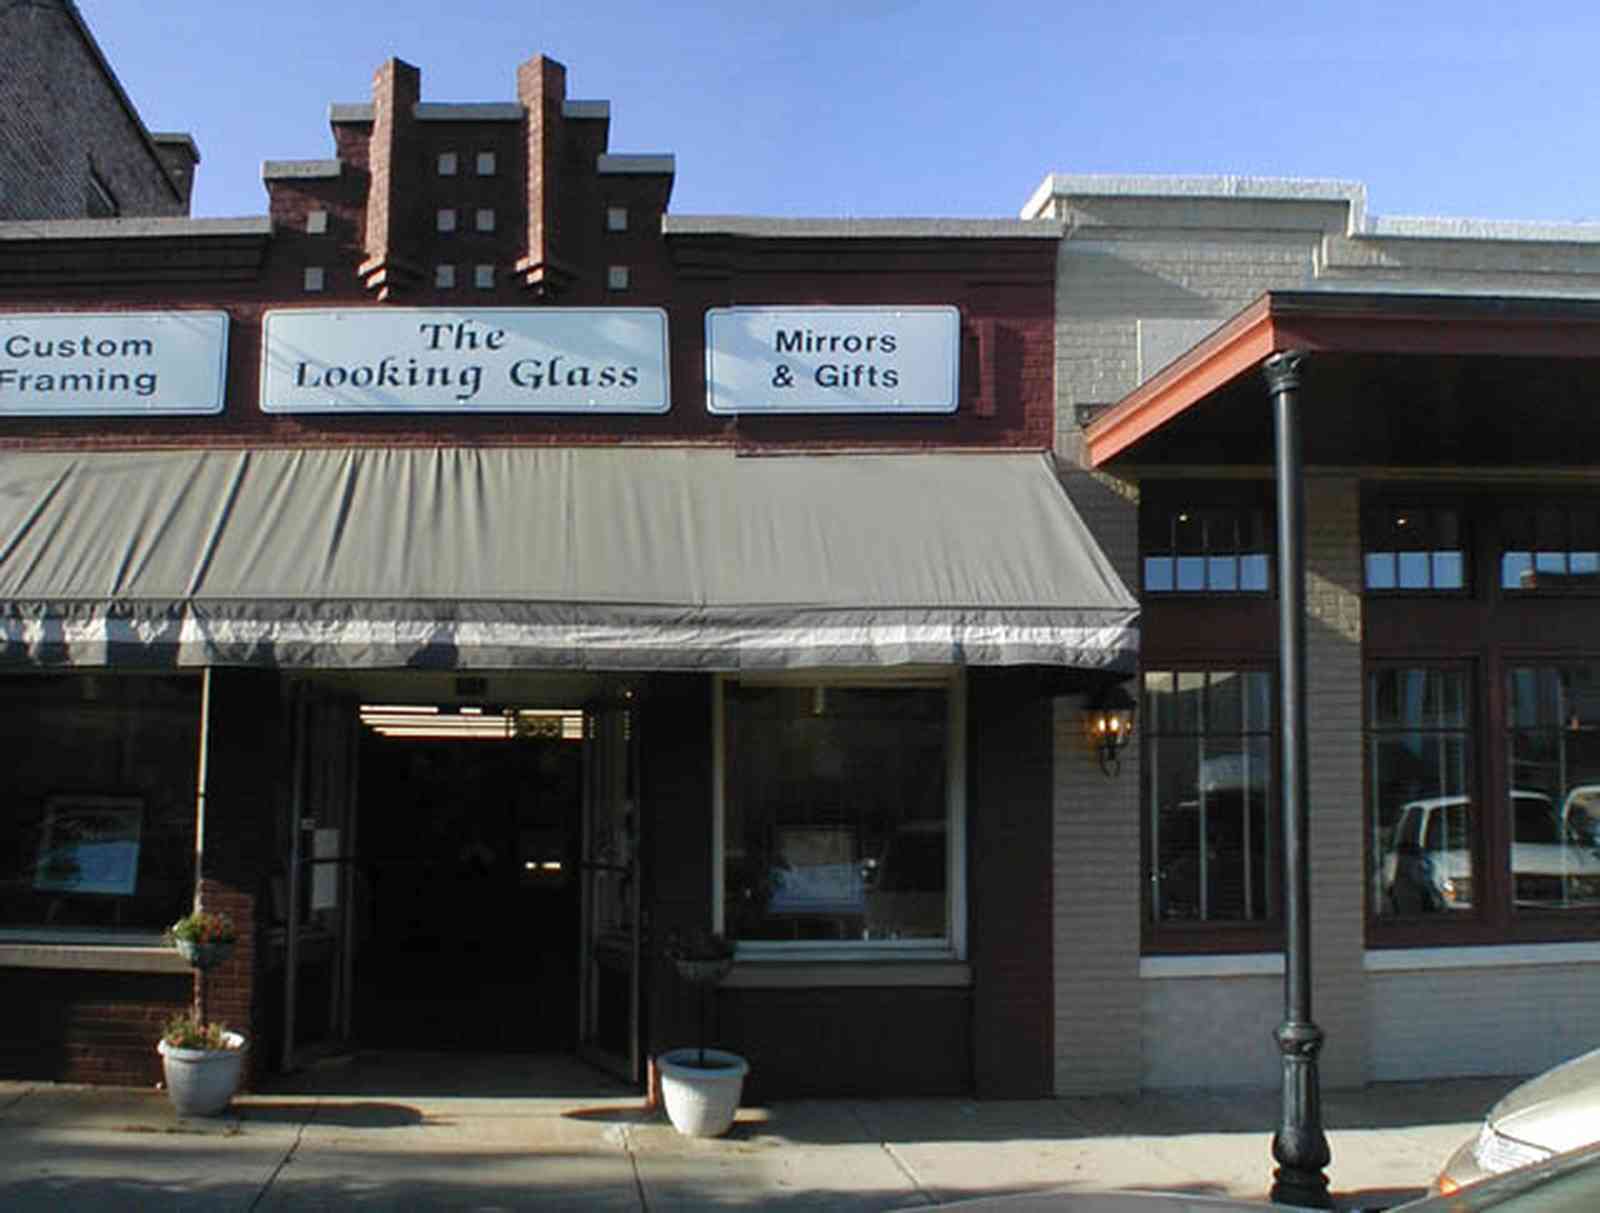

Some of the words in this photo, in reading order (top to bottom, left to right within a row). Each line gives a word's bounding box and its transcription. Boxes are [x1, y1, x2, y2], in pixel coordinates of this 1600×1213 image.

[5, 335, 153, 358] Custom
[420, 321, 505, 350] The
[776, 330, 897, 353] Mirrors
[0, 368, 158, 396] Framing
[295, 356, 482, 400] Looking
[509, 356, 640, 390] Glass
[771, 364, 794, 388] &
[815, 364, 899, 388] Gifts
